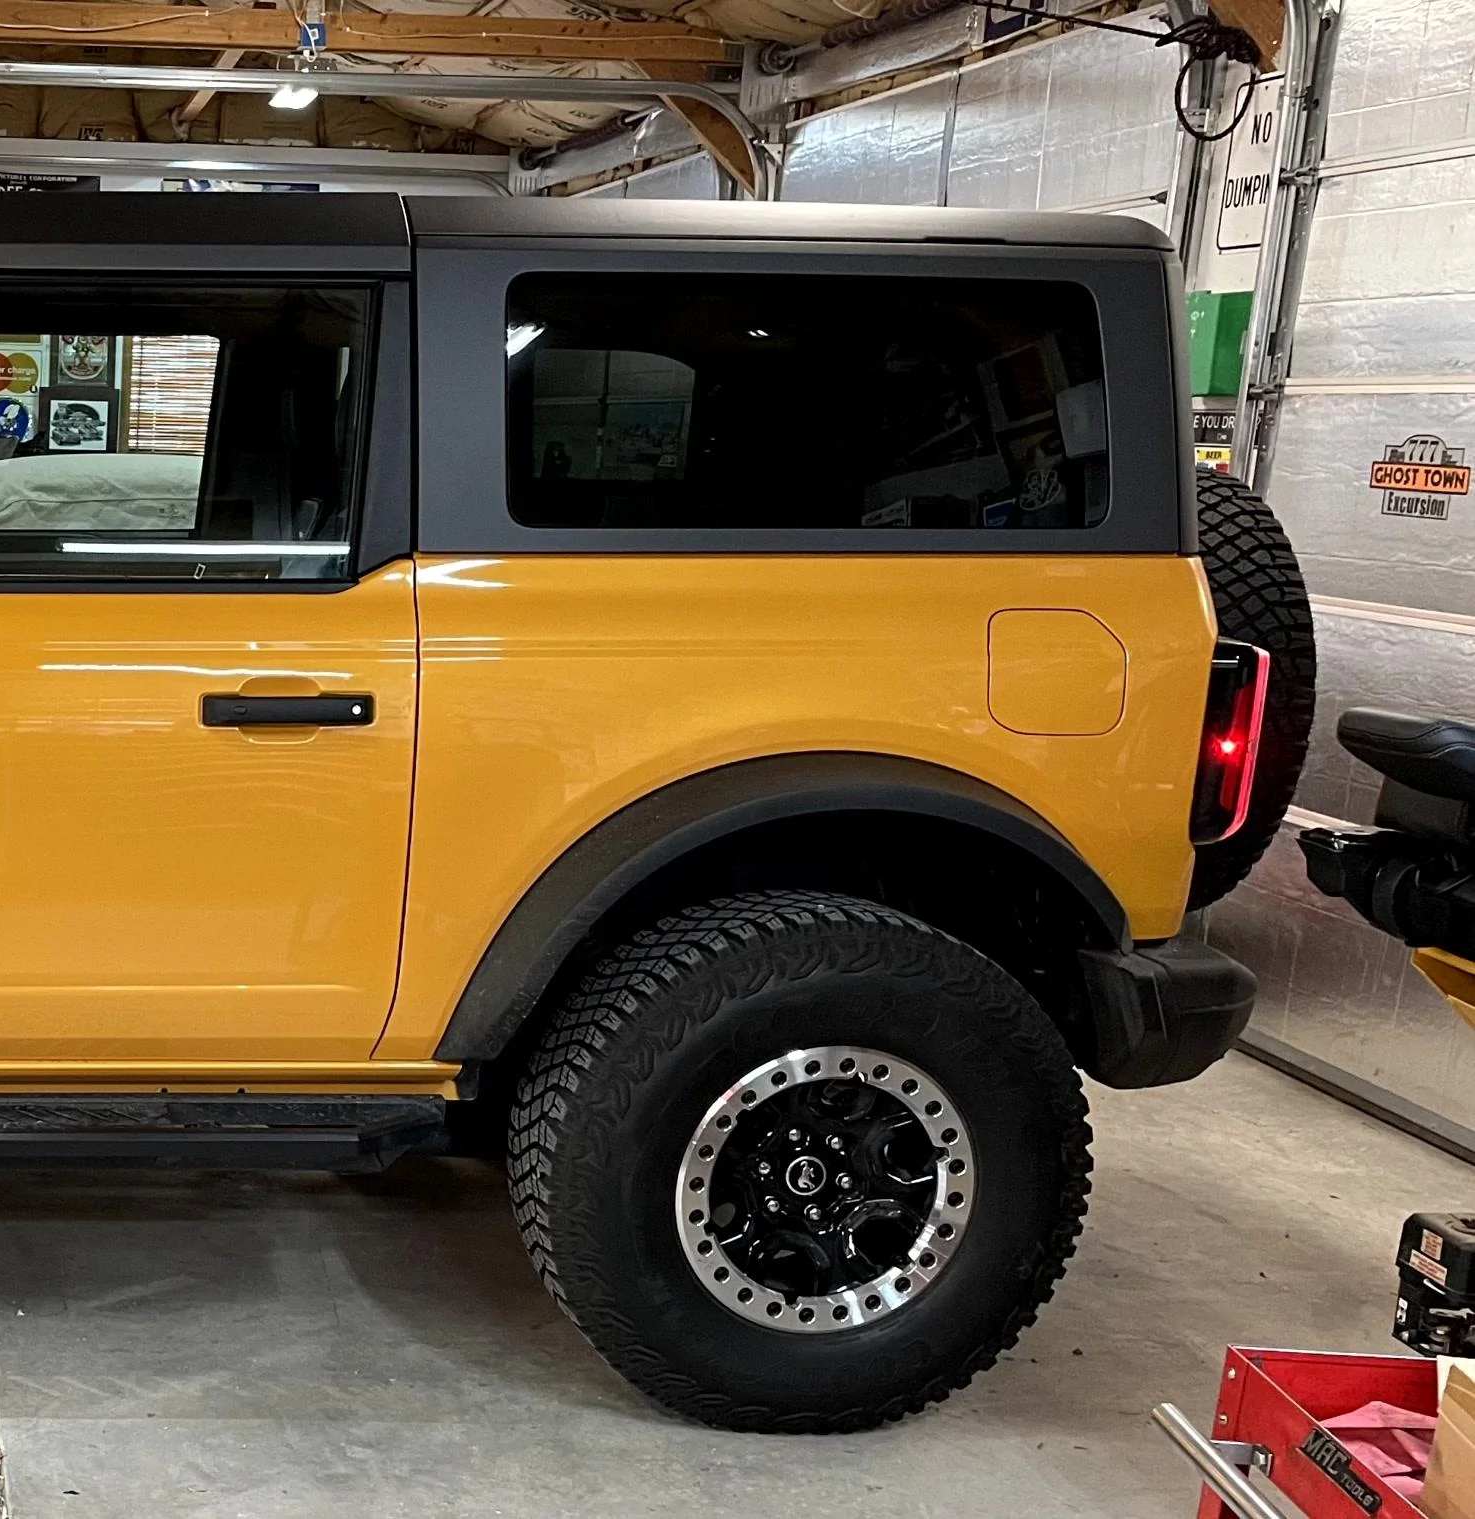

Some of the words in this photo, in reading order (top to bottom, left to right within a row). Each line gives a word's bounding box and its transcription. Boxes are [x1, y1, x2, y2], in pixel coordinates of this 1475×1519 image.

[1251, 112, 1272, 145] NO
[8, 366, 37, 376] charge
[1202, 415, 1220, 428] YOU
[1205, 451, 1222, 459] BEER
[1408, 440, 1440, 462] 777
[1374, 467, 1419, 486] GHOST
[1424, 469, 1466, 489] TOWN
[1387, 491, 1446, 517] Excursion
[1303, 1428, 1349, 1475] MAC
[1339, 1474, 1374, 1507] TOOLS
